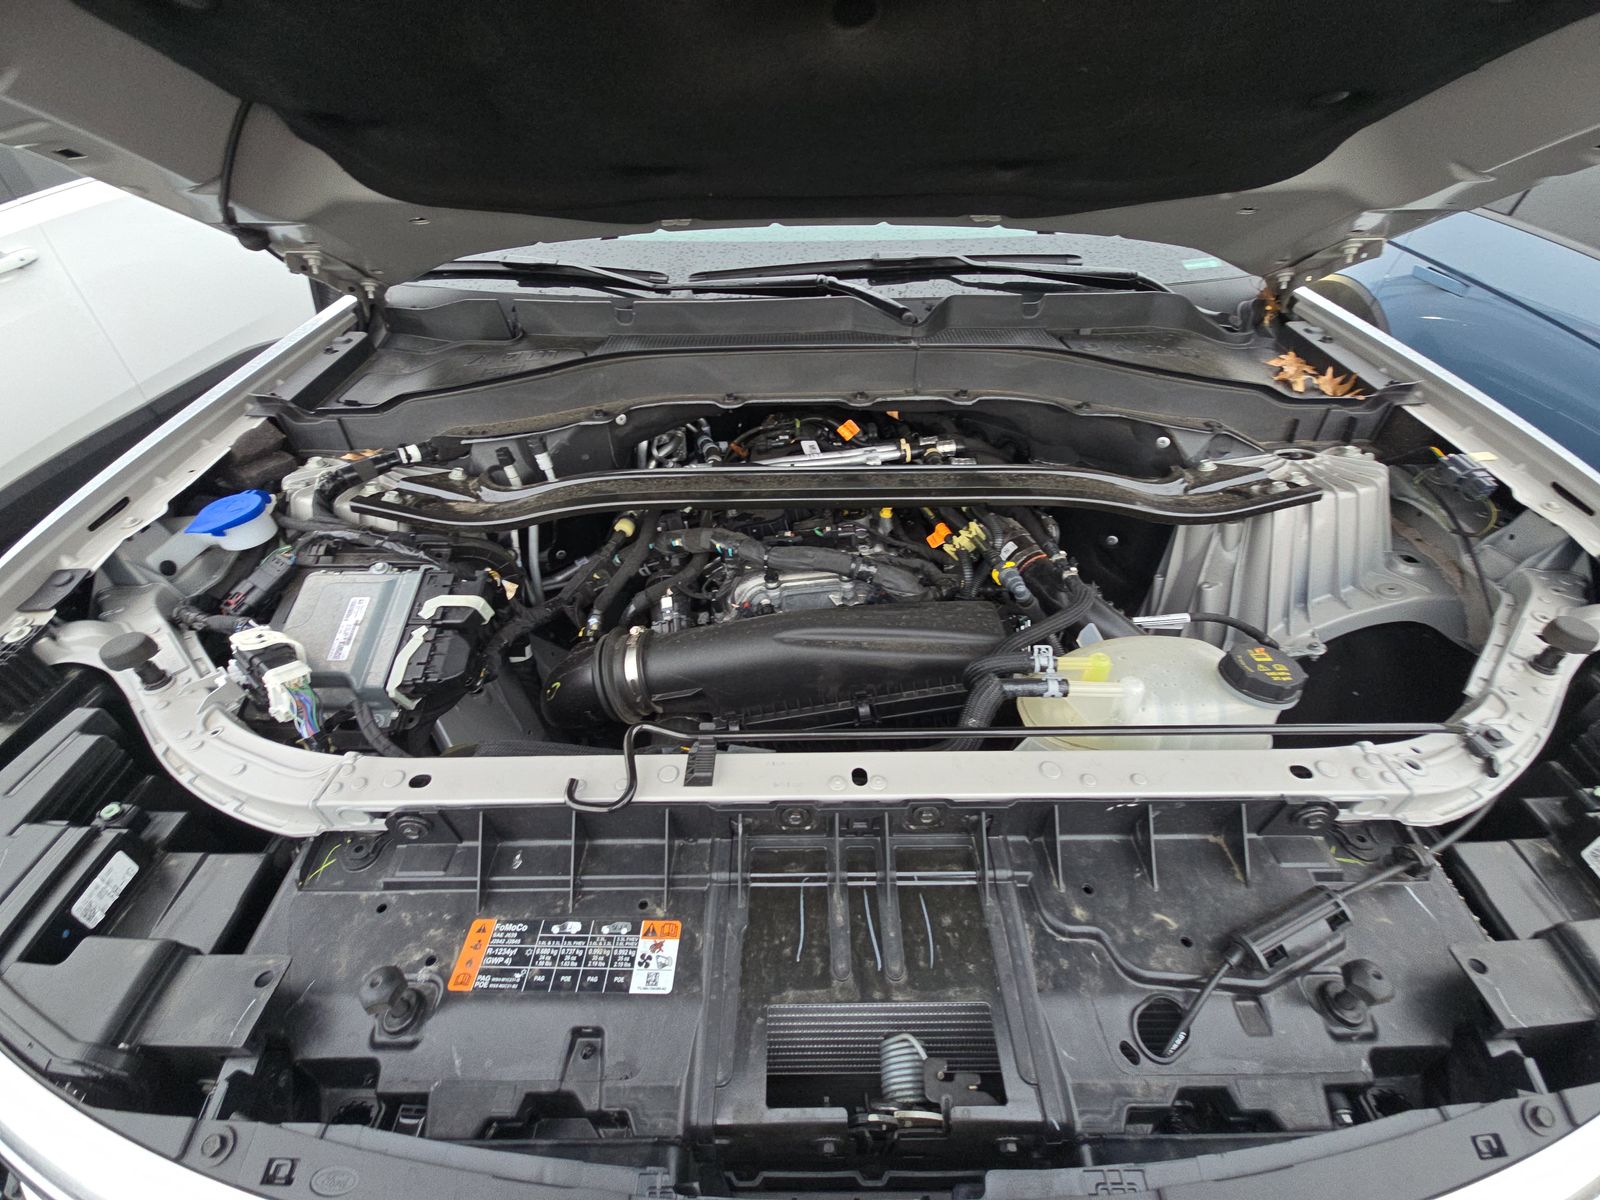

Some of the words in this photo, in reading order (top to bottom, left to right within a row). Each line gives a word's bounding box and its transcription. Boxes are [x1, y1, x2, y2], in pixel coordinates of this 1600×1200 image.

[494, 923, 528, 932] FoMoCo
[486, 948, 518, 957] R-1234yf
[551, 948, 558, 956] kg
[483, 957, 504, 965] (GWP
